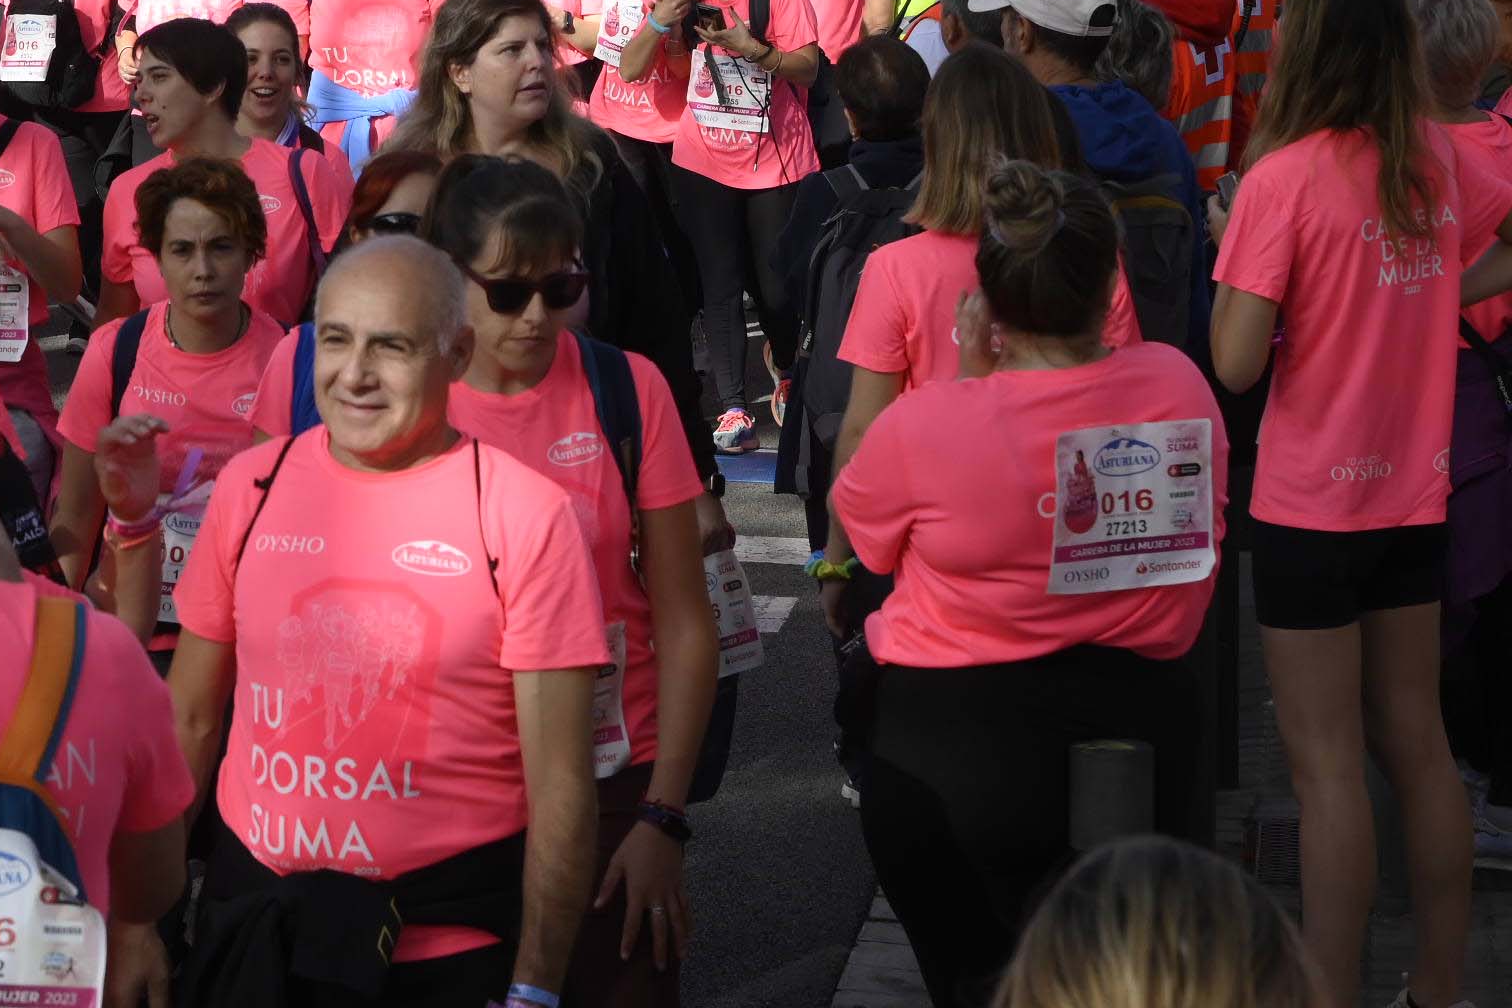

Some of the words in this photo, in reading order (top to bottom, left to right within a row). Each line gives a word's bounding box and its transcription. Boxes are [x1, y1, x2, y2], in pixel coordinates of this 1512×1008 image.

[322, 47, 348, 63] TU
[1377, 255, 1445, 287] MUJER
[1097, 454, 1155, 470] ASTURIANA
[1167, 442, 1200, 453] SUMA
[1330, 463, 1392, 482] OYSHO
[1100, 488, 1154, 514] 016
[1105, 519, 1148, 536] 27213
[255, 534, 325, 553] OYSHO
[1070, 546, 1109, 558] CARRERA
[1110, 543, 1123, 553] DE
[1124, 541, 1136, 551] LA
[1137, 539, 1172, 550] MUJER
[1173, 537, 1196, 547] 2023
[1064, 567, 1110, 584] OYSHO
[1148, 559, 1202, 574] Santander
[252, 682, 284, 729] TU
[253, 752, 421, 801] DORSAL
[248, 803, 374, 862] SUMA
[44, 990, 78, 1004] 2023
